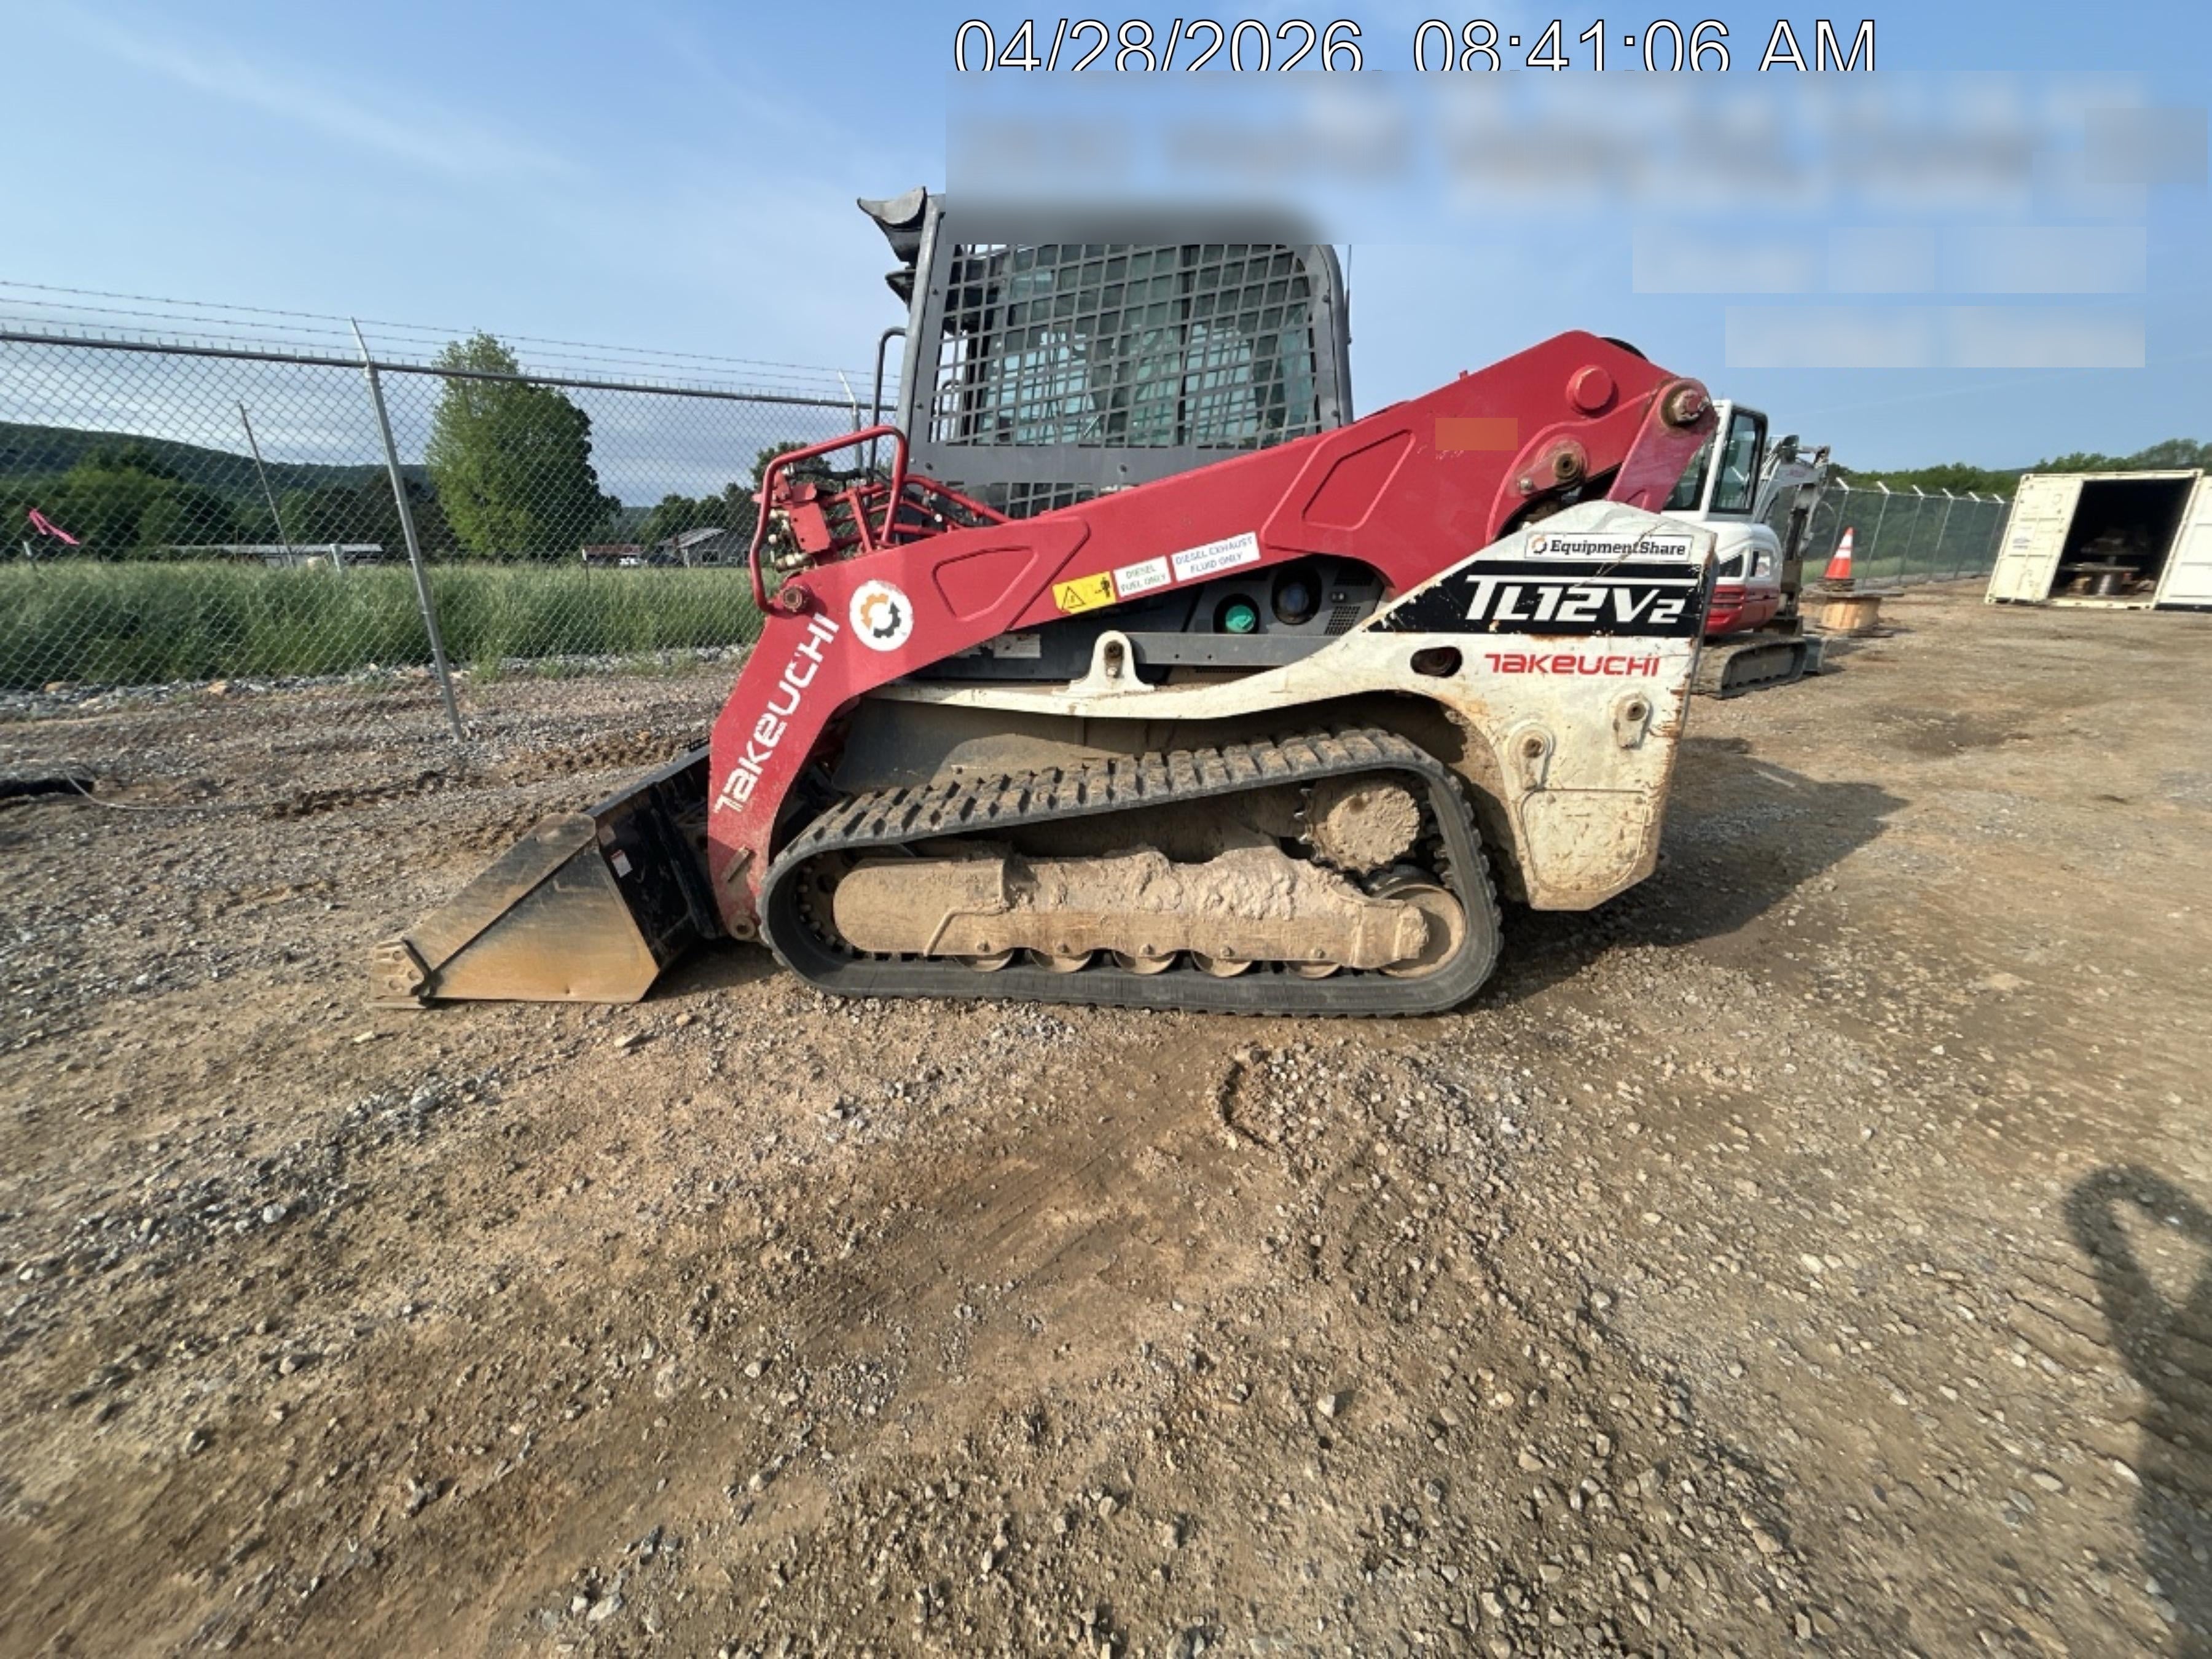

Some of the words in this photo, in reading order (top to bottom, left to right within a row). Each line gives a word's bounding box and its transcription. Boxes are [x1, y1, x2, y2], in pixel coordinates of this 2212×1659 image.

[1175, 551, 1207, 565] DIESEL
[1209, 536, 1252, 555] EXHAUST
[1550, 539, 1685, 555] EquipmentShare
[1190, 560, 1217, 573] FLUID
[1218, 552, 1243, 566] ONLY
[1126, 565, 1156, 579] DIESEL
[1145, 574, 1166, 586] ONLY
[1465, 575, 1698, 624] TL12V2
